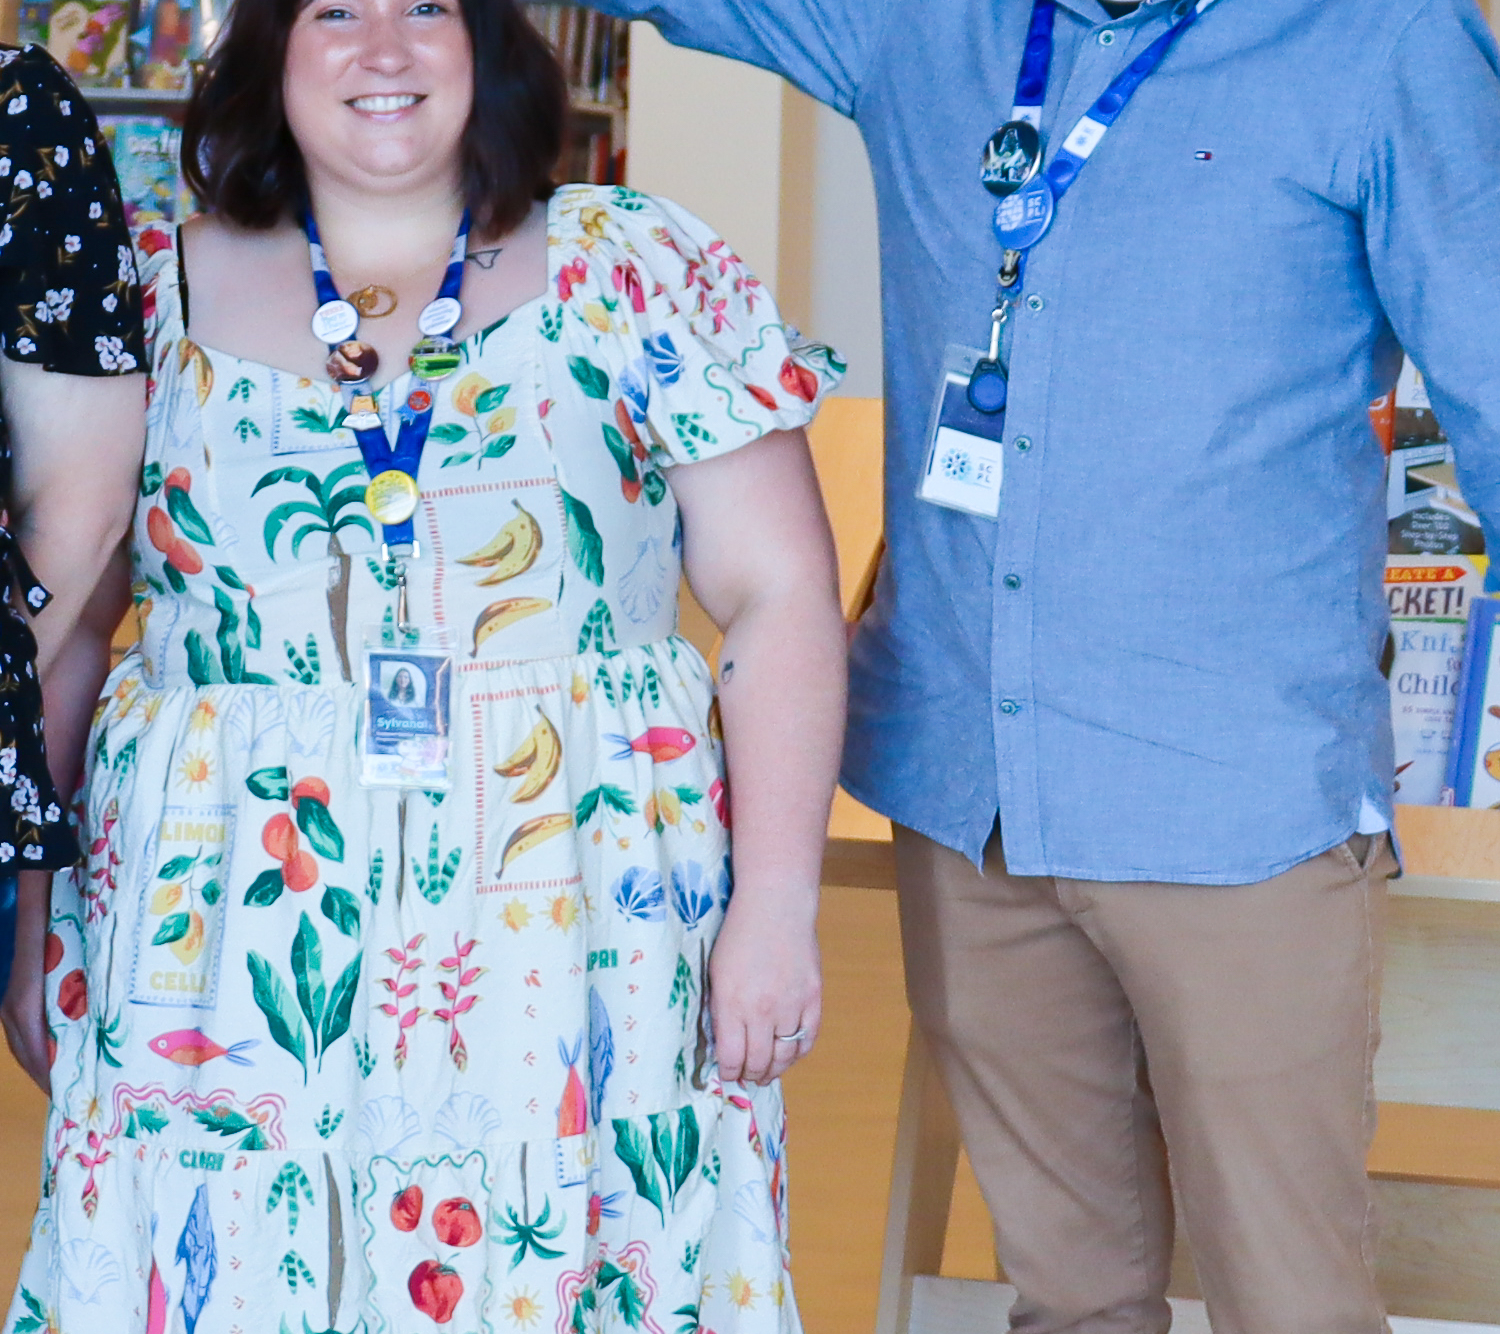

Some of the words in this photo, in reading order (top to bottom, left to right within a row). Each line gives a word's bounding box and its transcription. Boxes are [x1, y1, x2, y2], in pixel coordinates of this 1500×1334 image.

[1400, 529, 1460, 542] Step-by-Step
[1389, 567, 1437, 580] EATE
[1442, 567, 1456, 579] A
[1388, 586, 1466, 616] CKET!
